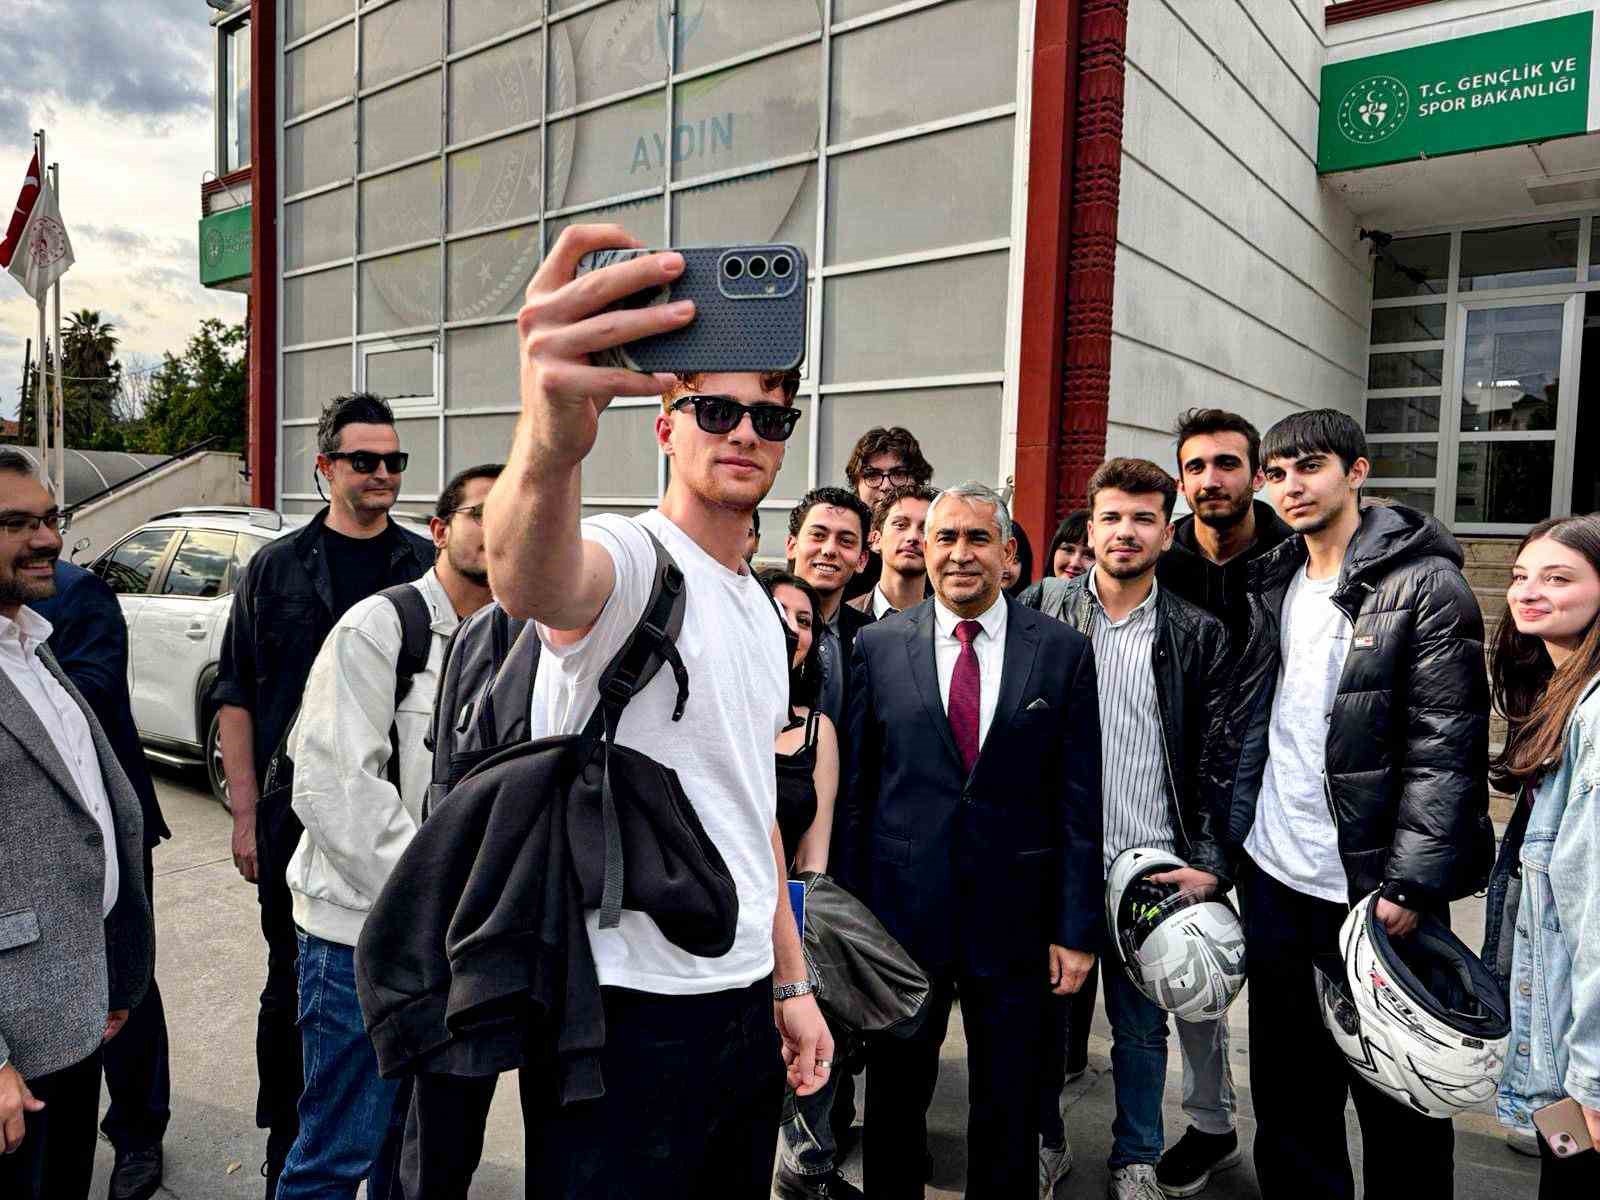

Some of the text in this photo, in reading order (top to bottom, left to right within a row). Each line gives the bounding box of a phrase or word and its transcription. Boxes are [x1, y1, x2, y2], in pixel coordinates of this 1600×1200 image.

[1418, 57, 1577, 98] T.C. GENÇLİK VE
[1418, 76, 1576, 117] SPOR BAKANLIĞI
[629, 112, 734, 175] AYDIN
